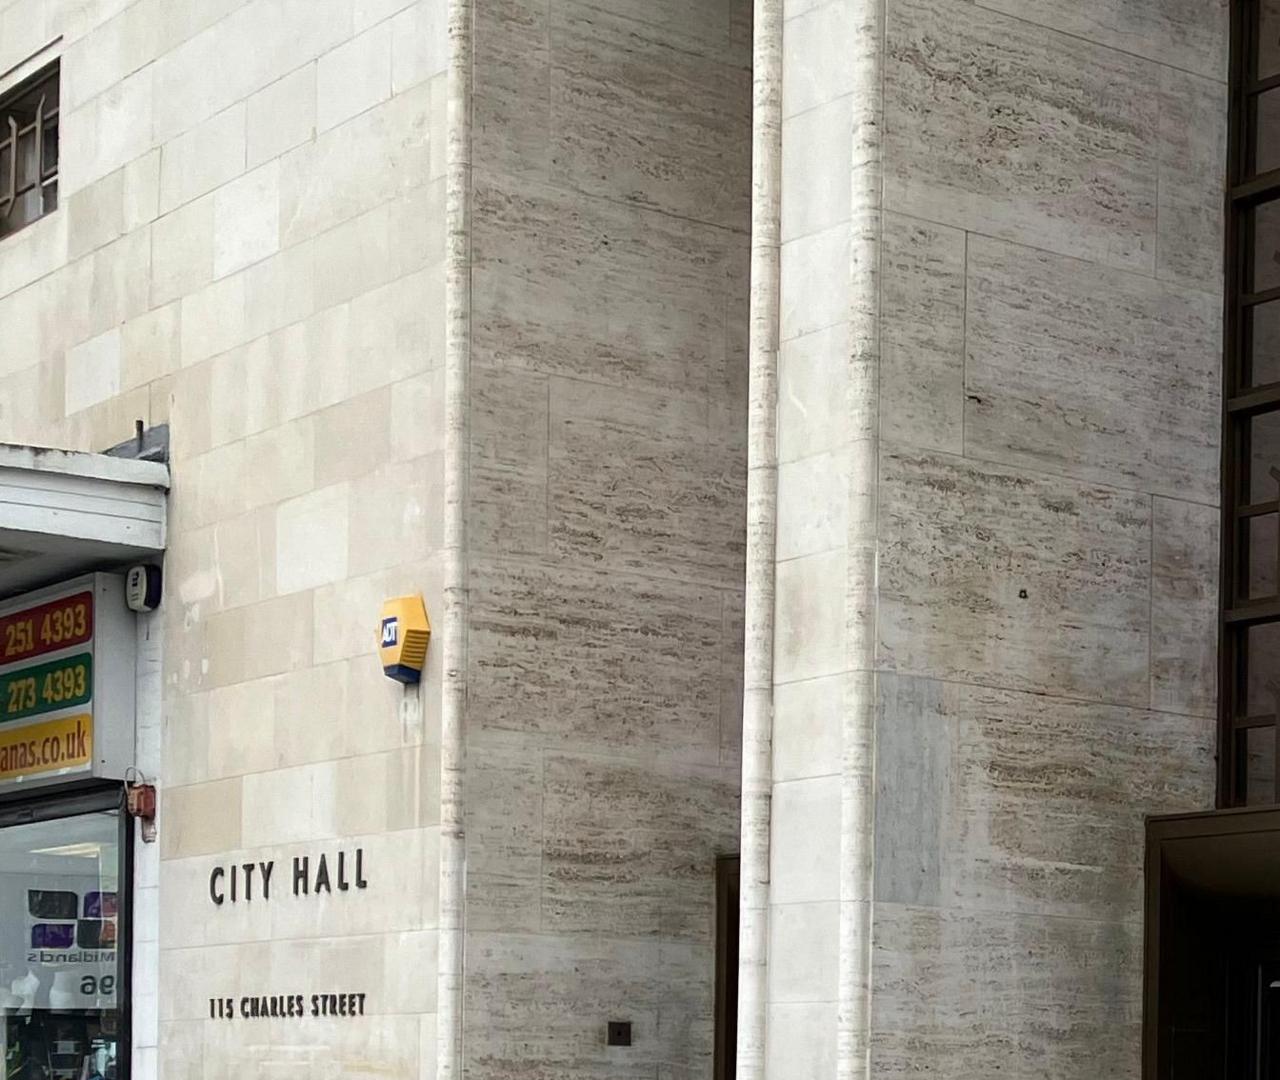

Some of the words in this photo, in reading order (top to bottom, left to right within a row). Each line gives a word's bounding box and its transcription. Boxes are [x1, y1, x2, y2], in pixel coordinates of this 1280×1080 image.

[5, 618, 34, 656] 251
[41, 603, 86, 644] 4393
[7, 677, 36, 712] 273
[42, 665, 85, 703] 4393
[0, 721, 87, 771] anas.co.uk
[209, 861, 275, 906] CITY
[293, 848, 368, 897] HALL
[209, 997, 234, 1020] 115
[240, 994, 304, 1020] CHARLES
[311, 993, 366, 1018] STREET
